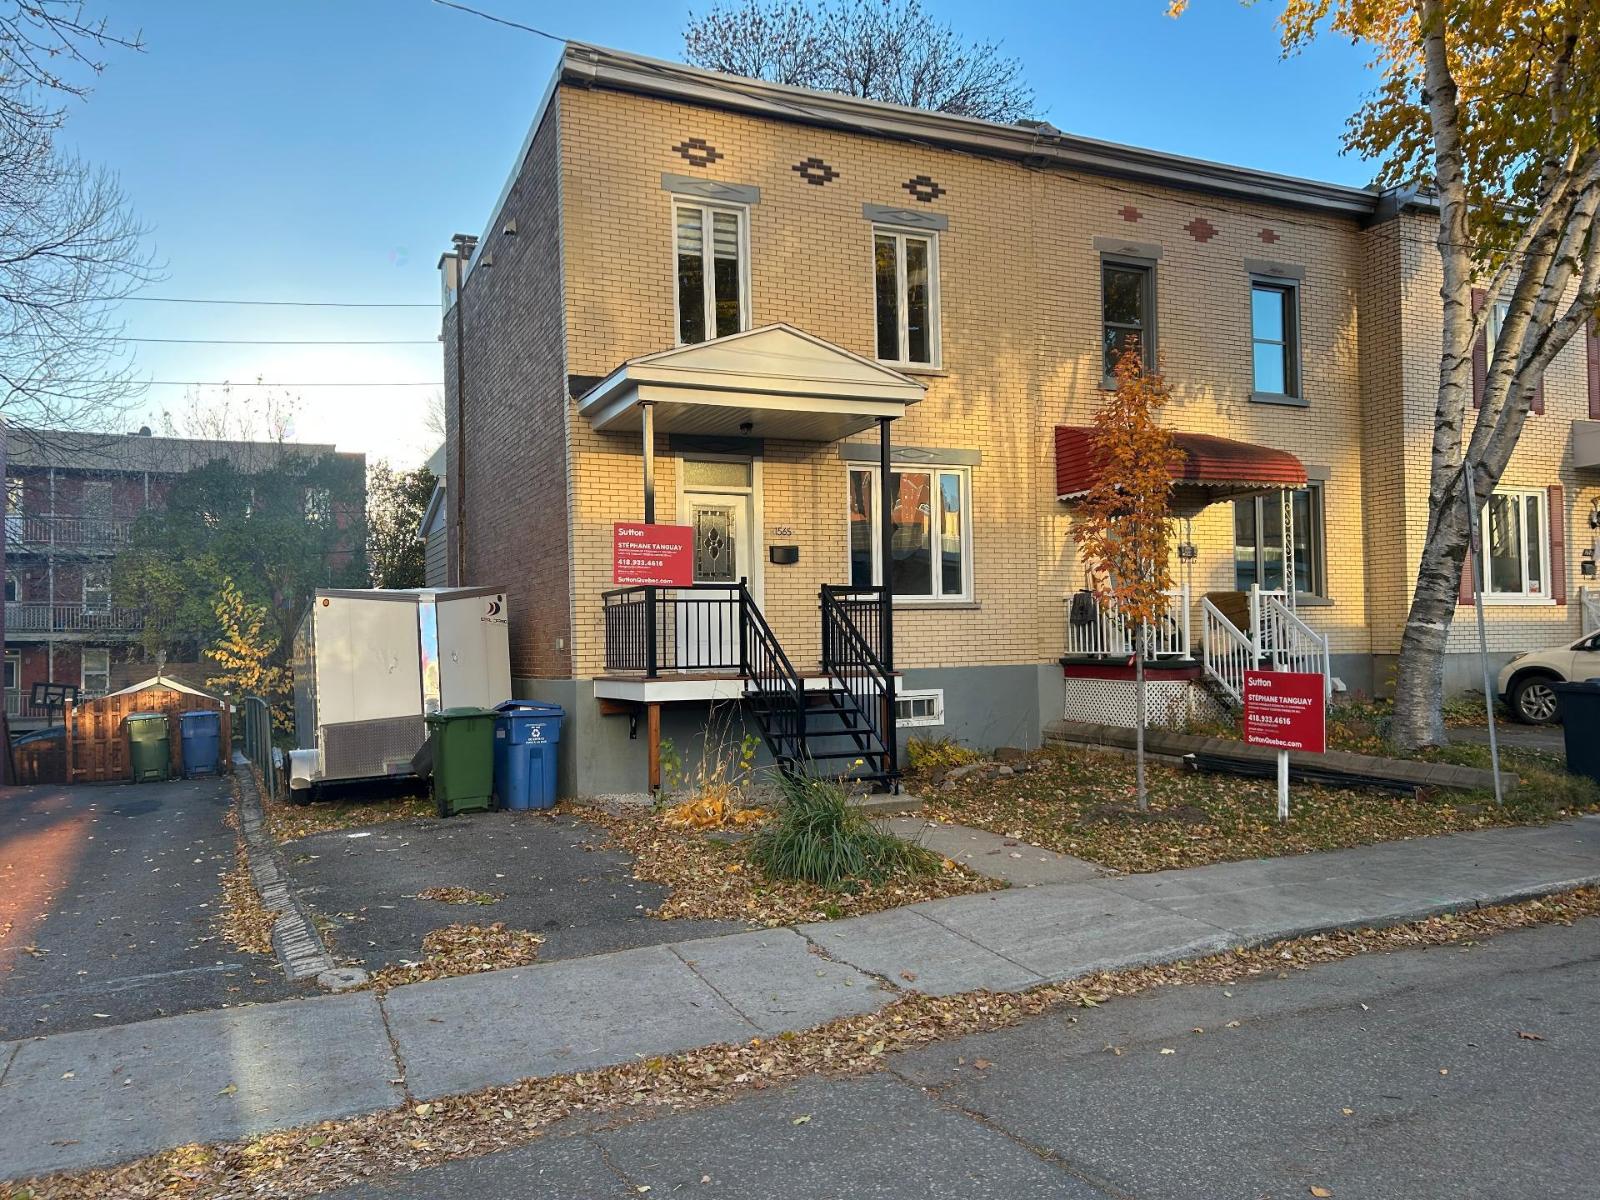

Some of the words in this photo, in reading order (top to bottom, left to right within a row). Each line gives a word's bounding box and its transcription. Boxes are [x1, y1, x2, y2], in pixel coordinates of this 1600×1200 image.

[618, 528, 644, 537] Sutton
[652, 543, 683, 551] TANGUAY
[1248, 677, 1272, 687] Sutton
[1248, 694, 1278, 703] STÉPHANE
[1279, 696, 1313, 706] TANGUAY
[1248, 714, 1291, 725] 418.933.4616
[1248, 735, 1303, 748] SuttonQuebec.com
